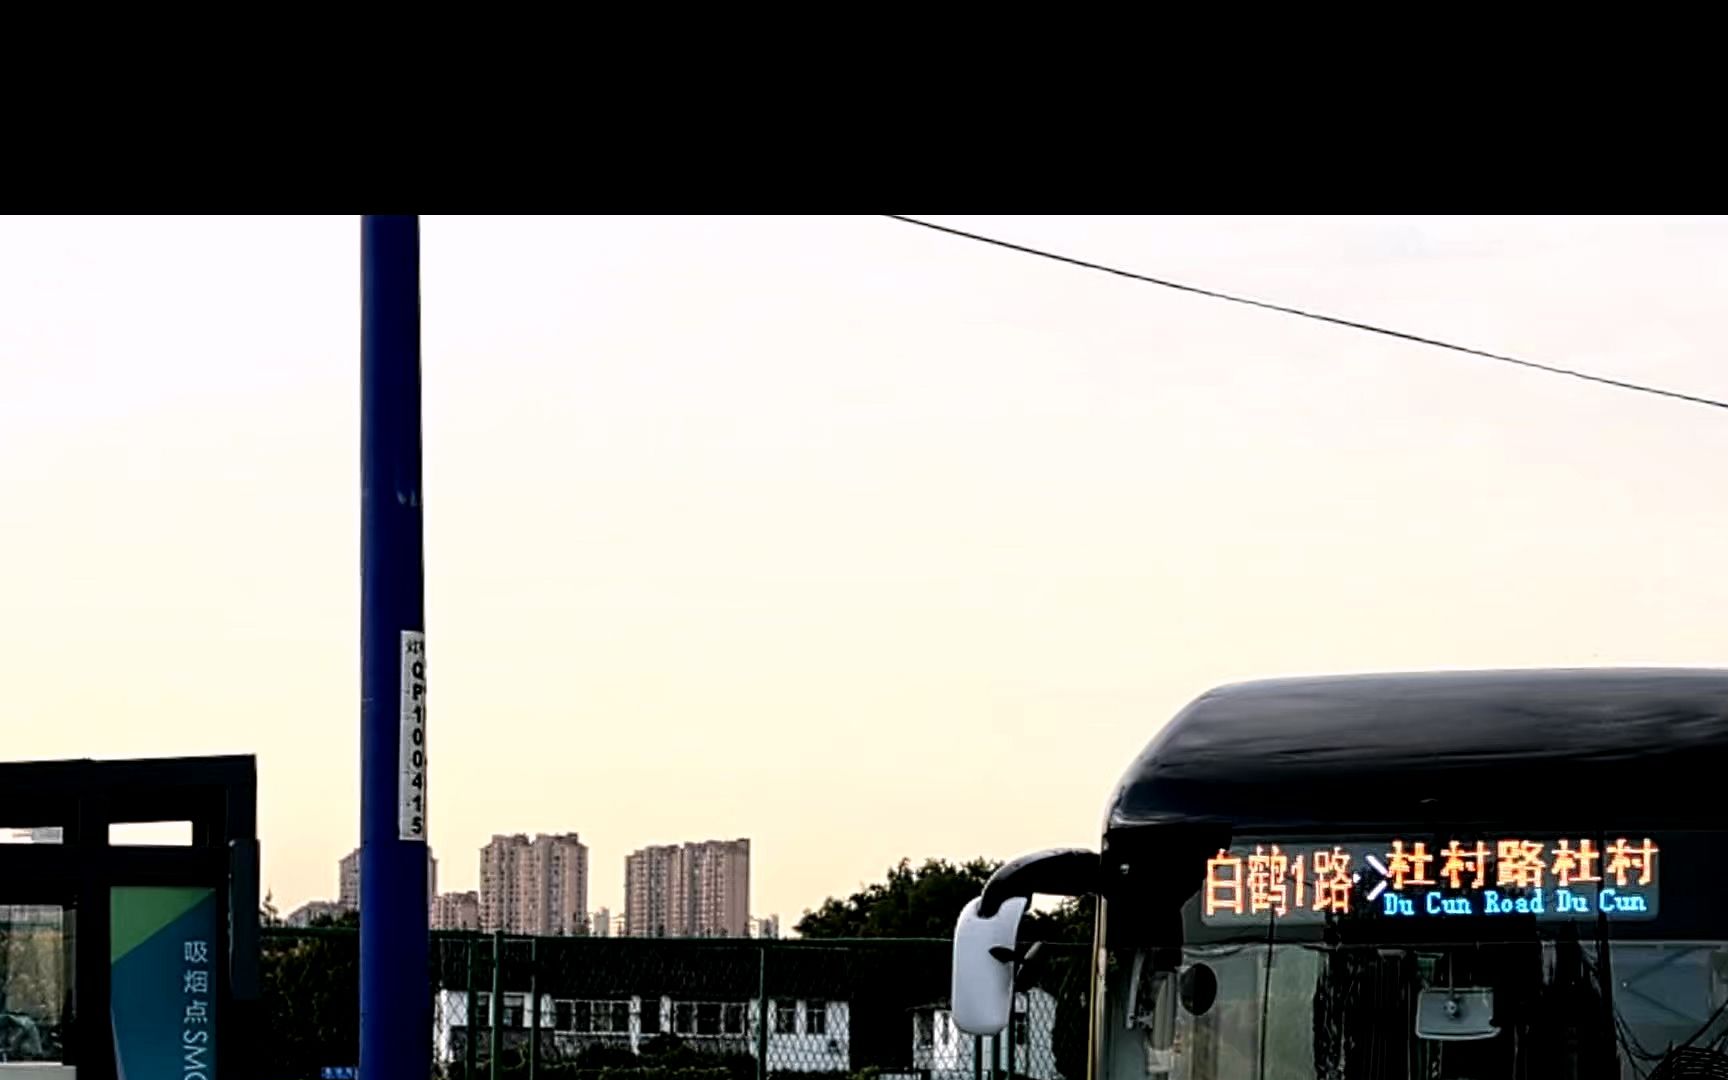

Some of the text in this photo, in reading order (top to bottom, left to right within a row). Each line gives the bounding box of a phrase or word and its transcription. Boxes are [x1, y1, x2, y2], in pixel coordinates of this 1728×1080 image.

[1206, 838, 1659, 917] 白鹤1路 杜村路杜村
[1384, 888, 1647, 916] Du Cun Road Du Cun
[183, 940, 209, 1024] 吸烟点
